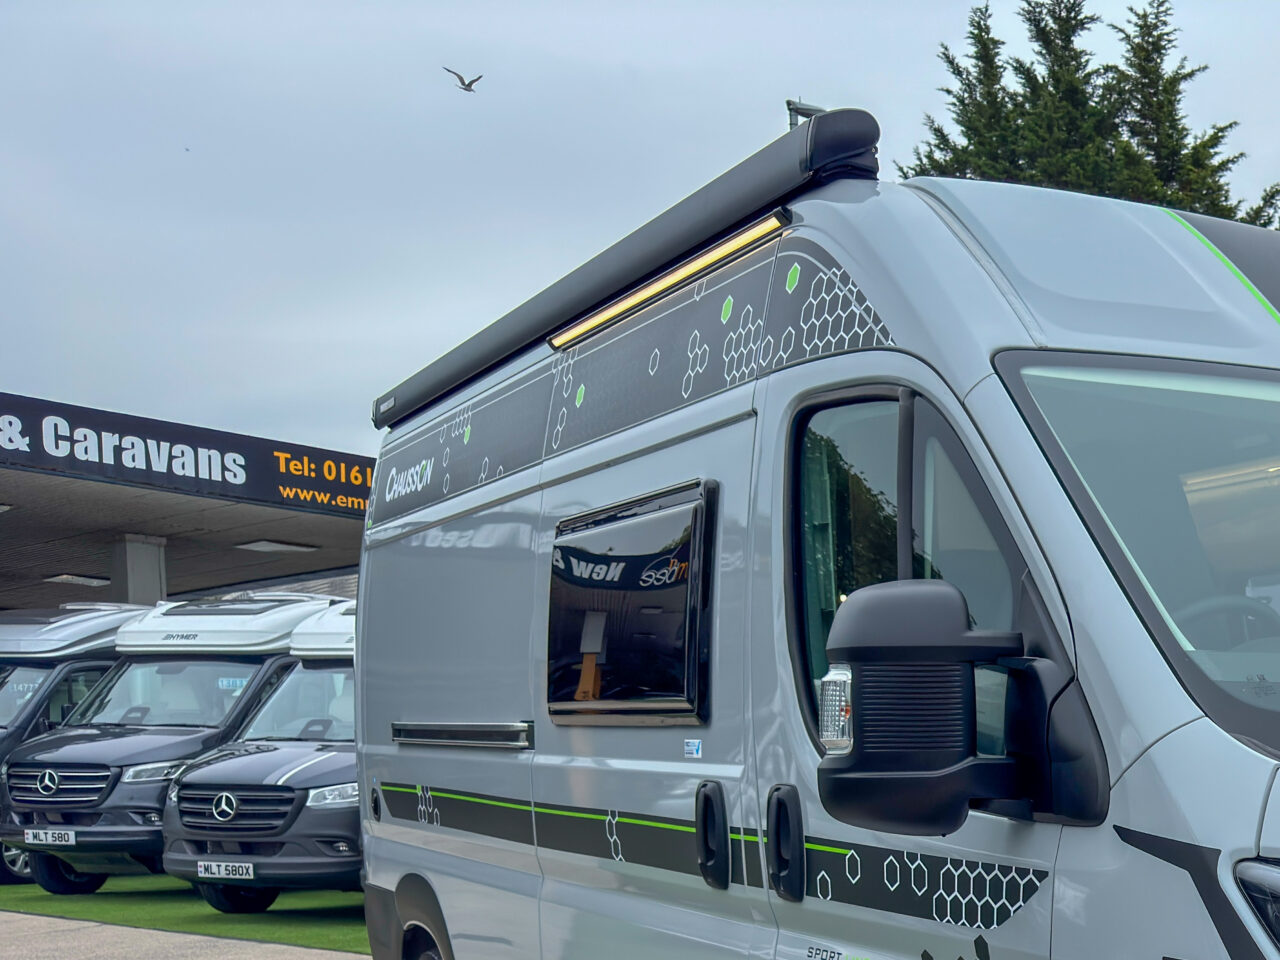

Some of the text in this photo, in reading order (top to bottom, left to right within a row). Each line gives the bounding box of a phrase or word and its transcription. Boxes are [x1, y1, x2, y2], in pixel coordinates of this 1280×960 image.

[0, 415, 247, 485] & Caravans
[273, 451, 373, 487] Tel: 0161
[163, 633, 199, 641] HYMER
[32, 831, 70, 843] MLT 580
[203, 864, 251, 877] MLT 580X
